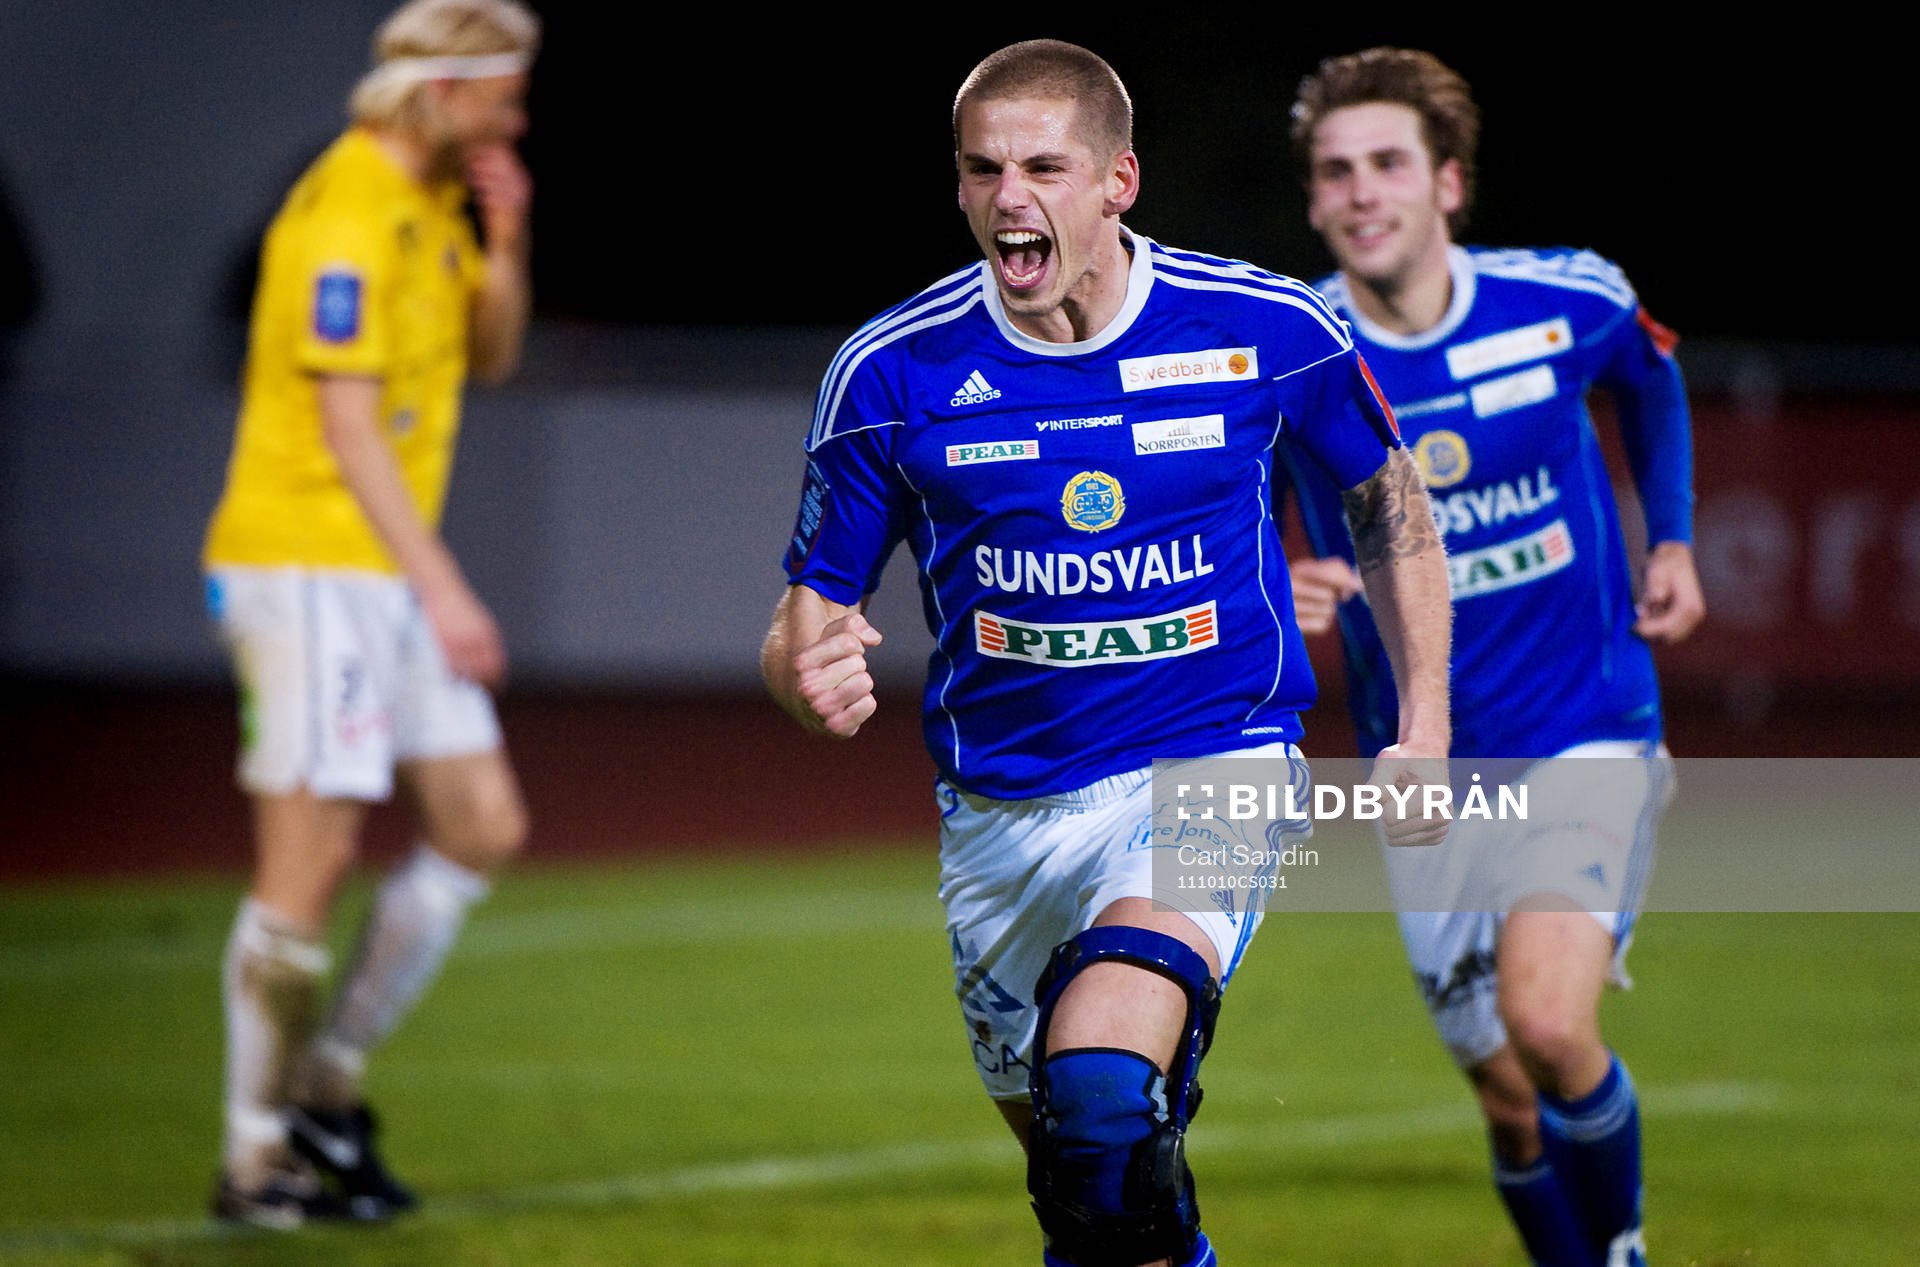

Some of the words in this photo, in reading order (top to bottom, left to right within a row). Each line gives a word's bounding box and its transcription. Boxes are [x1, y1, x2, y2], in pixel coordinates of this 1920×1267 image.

[1129, 358, 1223, 383] Swedbank
[950, 389, 1002, 407] adidas
[1050, 414, 1124, 431] INTERSPORT
[958, 443, 1027, 461] PEAB
[1137, 434, 1222, 452] NORRPORTEN
[975, 534, 1214, 596] SUNDSVALL
[1001, 617, 1190, 661] PEAB
